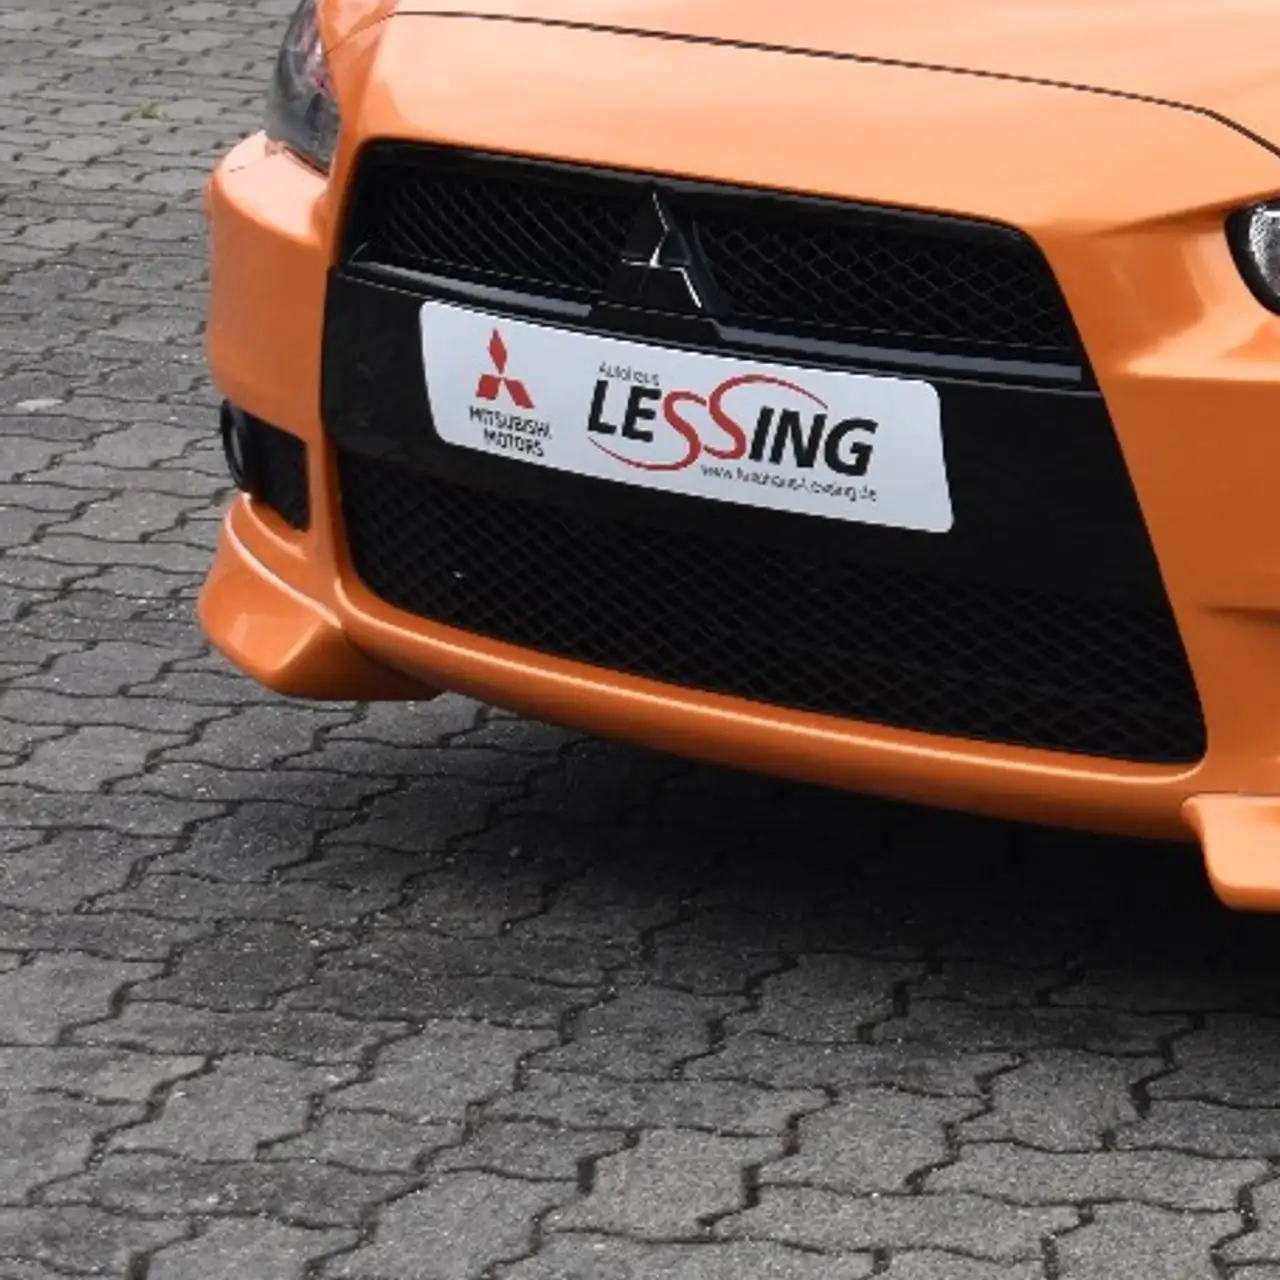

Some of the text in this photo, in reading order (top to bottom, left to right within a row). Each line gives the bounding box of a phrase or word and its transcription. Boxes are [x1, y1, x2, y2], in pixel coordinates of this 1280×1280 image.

[469, 406, 552, 439] MITSUBISHI
[587, 374, 879, 477] LESSING
[484, 428, 545, 457] MOTORS
